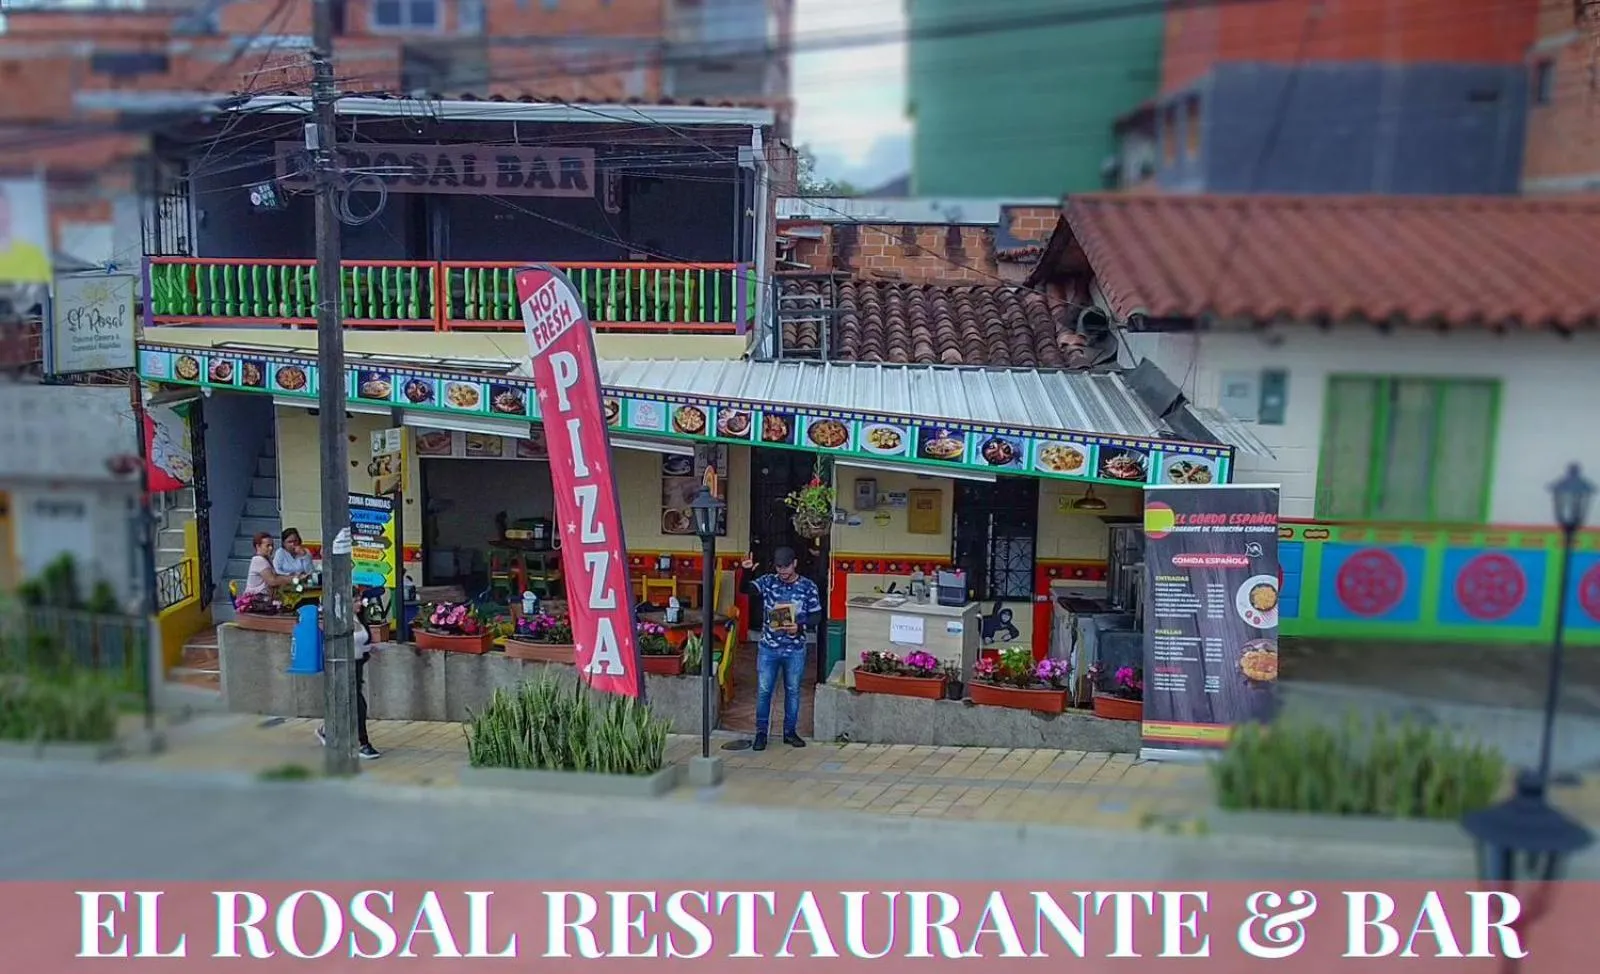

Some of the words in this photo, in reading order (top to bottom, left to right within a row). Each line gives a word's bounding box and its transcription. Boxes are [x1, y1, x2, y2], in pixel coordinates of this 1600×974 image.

[343, 152, 486, 187] ROSAL
[496, 155, 589, 190] BAR
[528, 280, 557, 322] HOT
[67, 306, 84, 332] El
[85, 304, 125, 334] Rosal
[532, 299, 573, 350] FRESH
[365, 497, 391, 509] COMIDAS
[549, 350, 625, 676] PIZZA
[1175, 513, 1187, 524] EL
[1190, 513, 1227, 524] GORDO
[1229, 511, 1278, 524] ESPAÑOL
[1172, 557, 1203, 565] COMIDA
[1205, 555, 1249, 565] ESPAÑOLA
